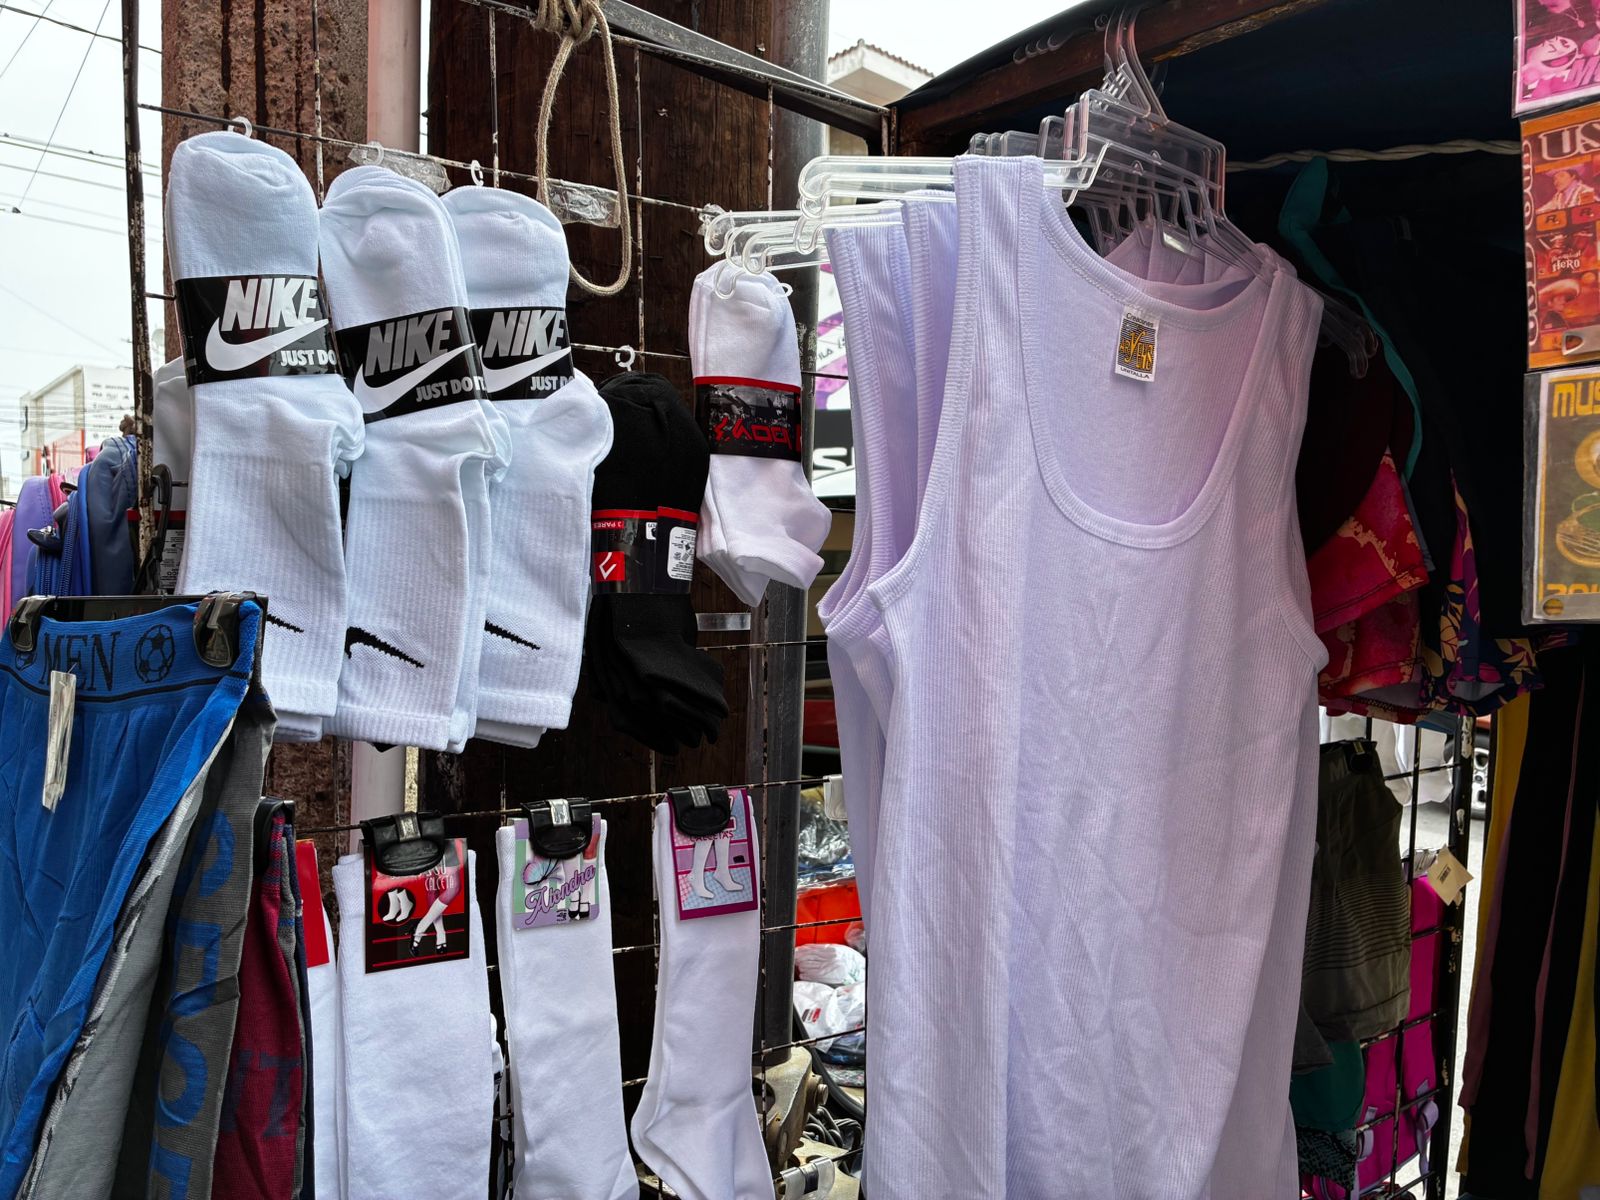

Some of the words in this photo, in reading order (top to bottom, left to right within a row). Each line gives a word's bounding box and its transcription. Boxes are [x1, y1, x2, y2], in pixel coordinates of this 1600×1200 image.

[221, 278, 318, 332] NIKE
[280, 350, 315, 366] JUST
[317, 350, 337, 365] DO
[364, 310, 454, 377] NIKE
[483, 310, 566, 358] NIKE
[416, 380, 448, 402] JUST
[449, 376, 473, 394] DO
[530, 375, 558, 391] JUST
[38, 631, 121, 691] MEN
[525, 864, 596, 925] Alondra
